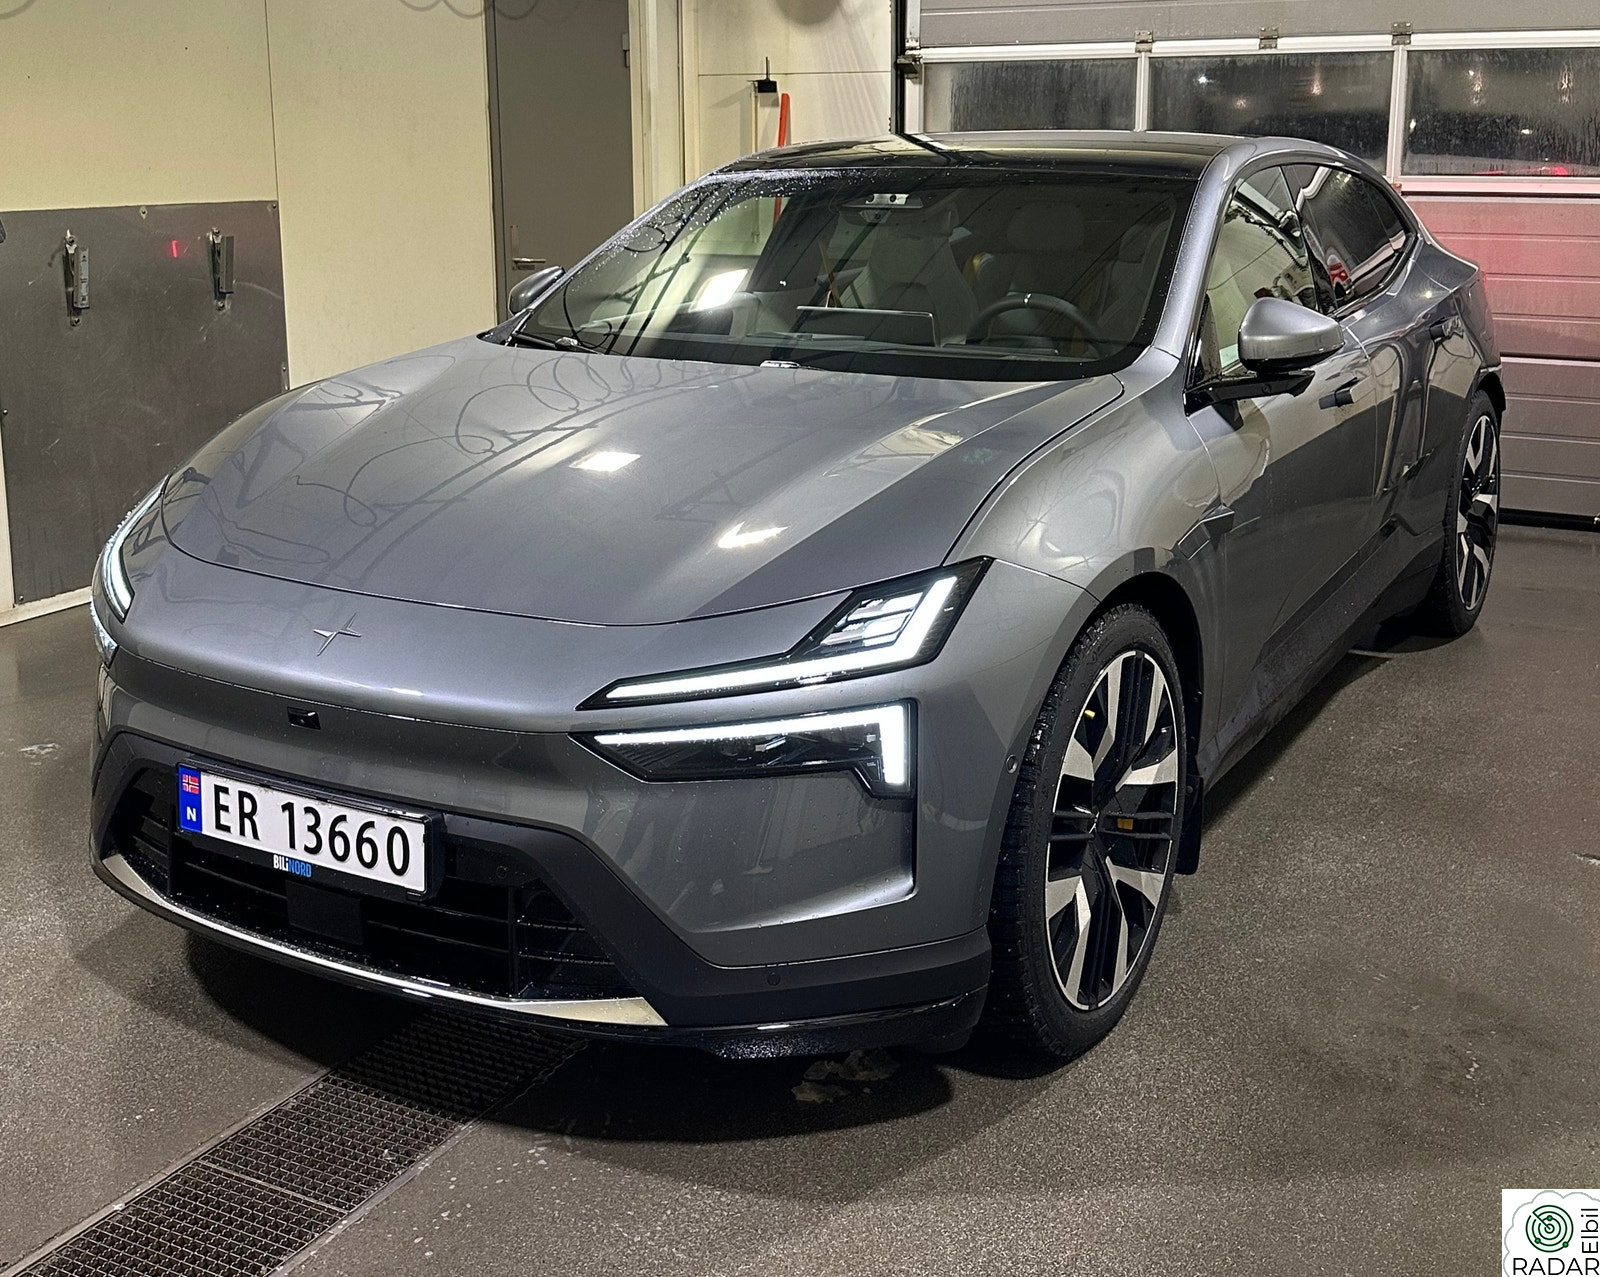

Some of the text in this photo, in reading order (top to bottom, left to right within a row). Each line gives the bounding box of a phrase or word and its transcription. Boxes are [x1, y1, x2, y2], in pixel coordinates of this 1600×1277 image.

[186, 806, 197, 822] N
[213, 783, 410, 877] ER 13660
